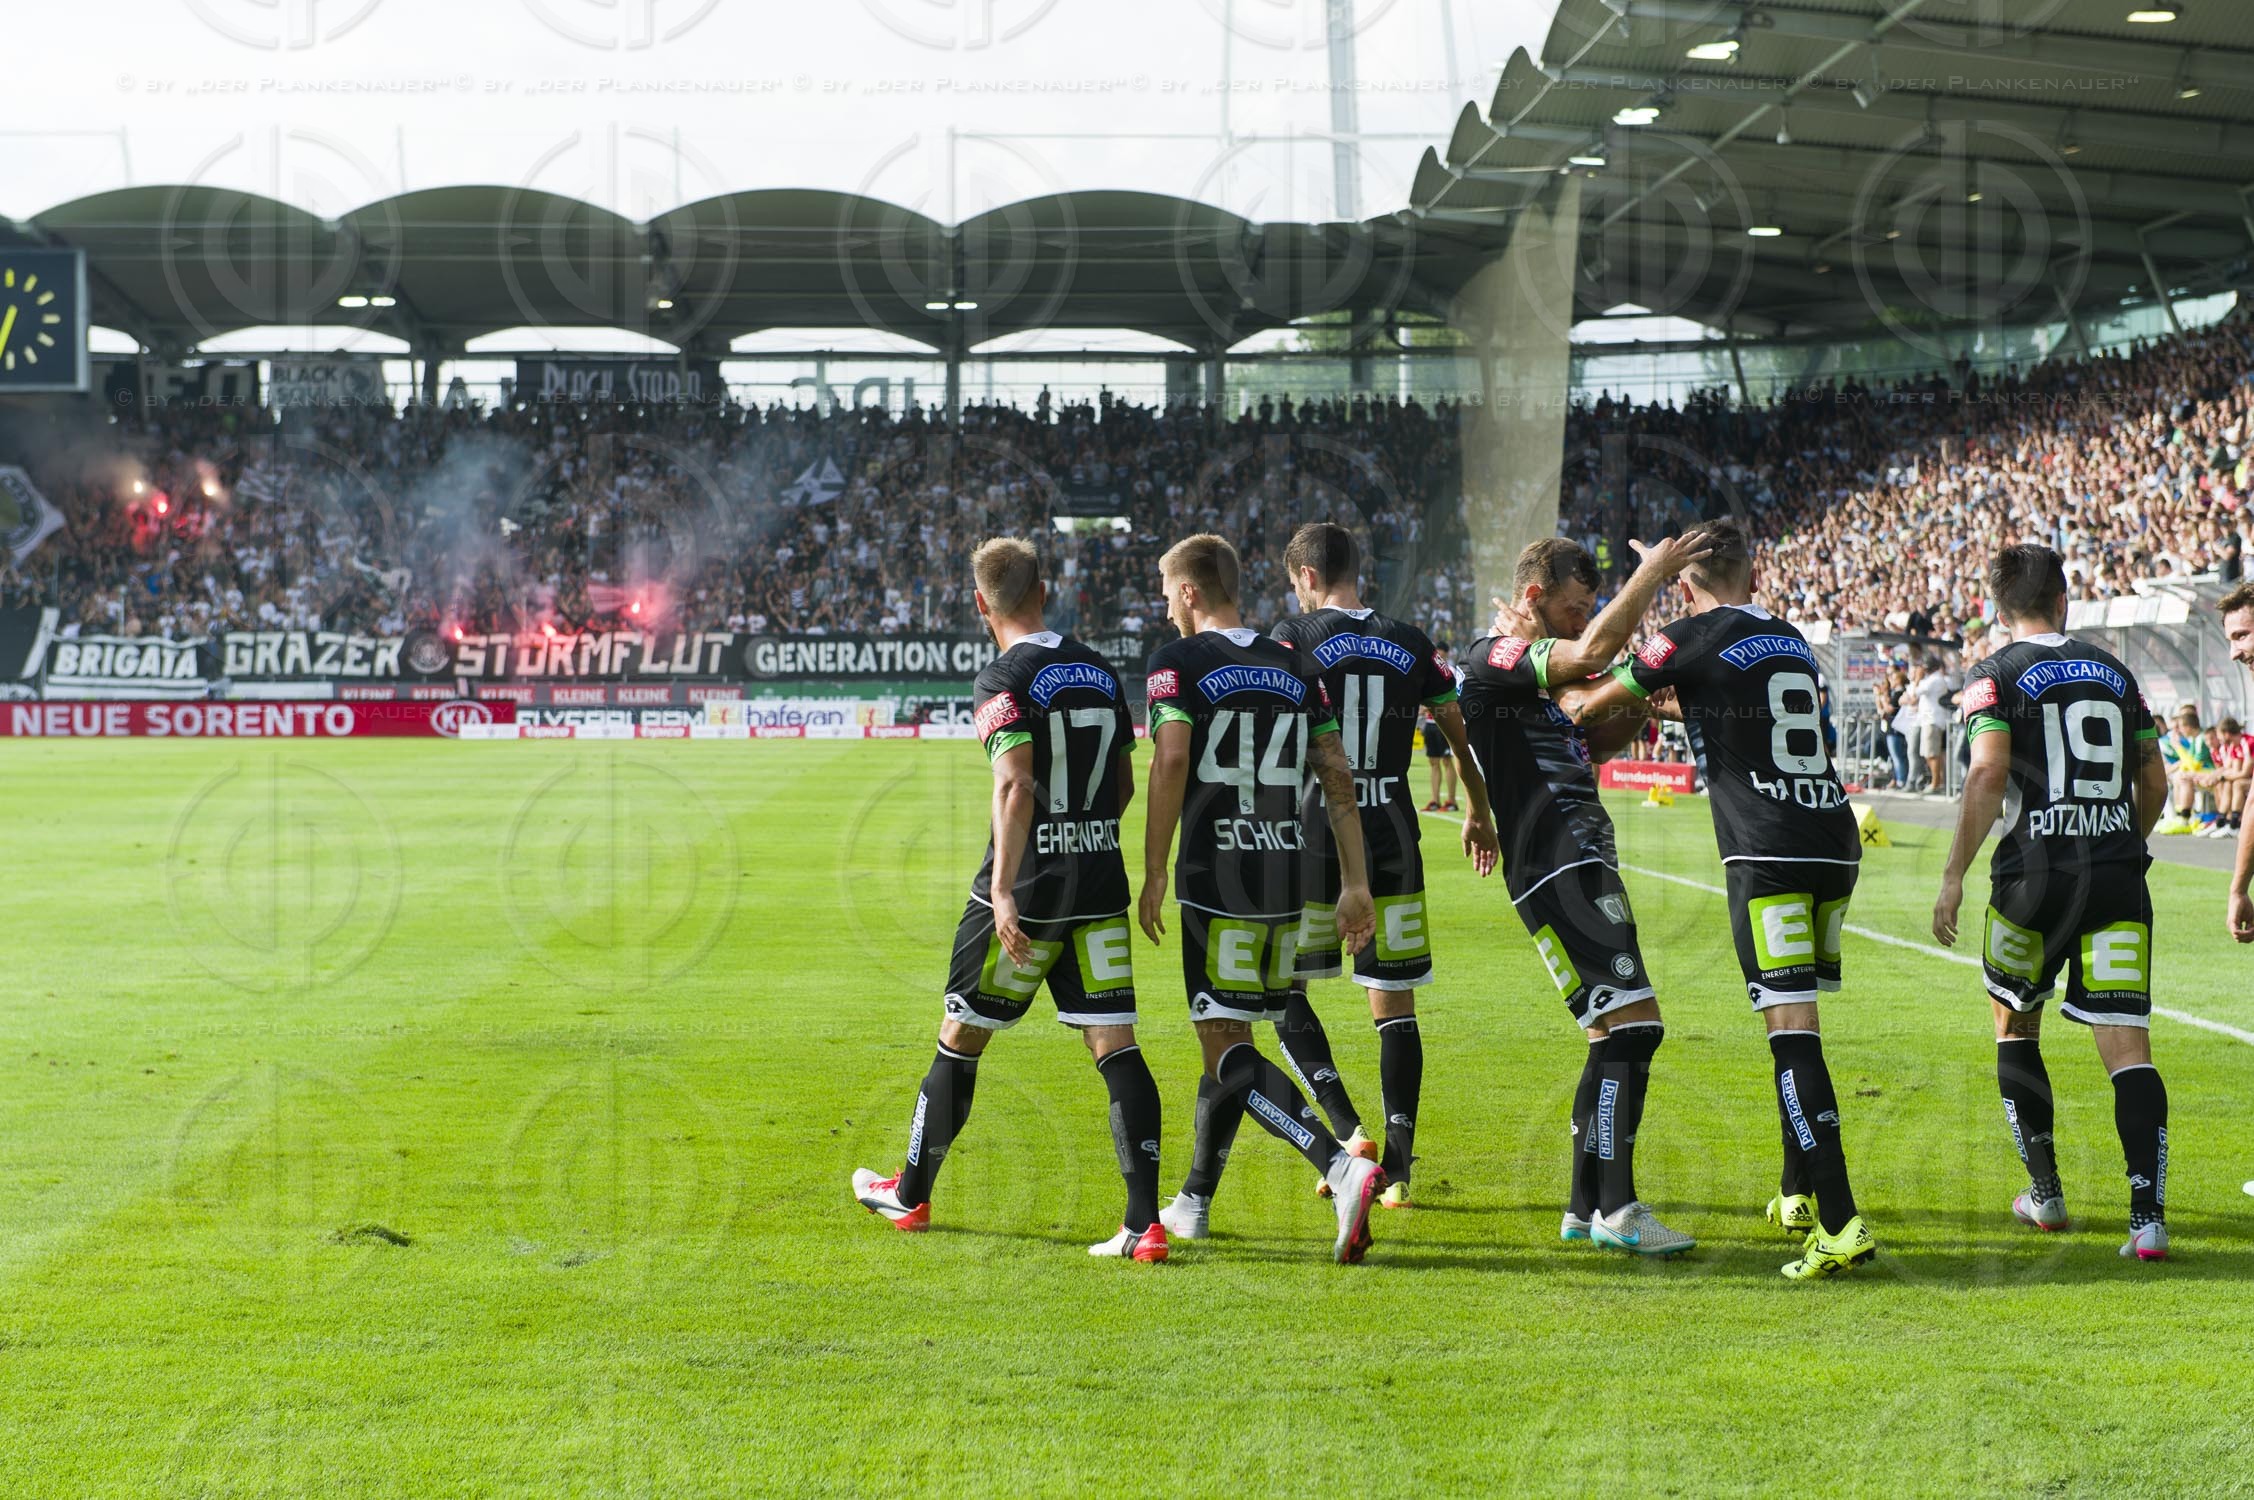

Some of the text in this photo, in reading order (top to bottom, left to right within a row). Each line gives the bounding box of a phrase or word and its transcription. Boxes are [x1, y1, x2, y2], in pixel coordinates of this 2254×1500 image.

[54, 643, 199, 678] BRIGATA
[224, 630, 404, 677] GRAZER
[454, 631, 735, 677] STURMFLUT
[755, 640, 947, 674] GENERATION
[413, 689, 456, 700] KLEIN
[553, 688, 606, 703] KLEINE
[618, 688, 670, 703] KLEINE
[690, 688, 742, 701] KLEINE
[1033, 666, 1114, 701] PUNTIGAMER
[1205, 669, 1302, 700] PUNTIGAMER
[2023, 663, 2123, 693] PUNTIGAMER
[12, 704, 131, 737] NEUE
[146, 703, 355, 737] SORENTO
[440, 708, 482, 730] KIA
[1342, 673, 1385, 770] 11
[1767, 671, 1828, 775] 8
[1049, 707, 1117, 814] 17
[1197, 709, 1309, 815] 44
[2042, 699, 2124, 802] 19
[1612, 769, 1687, 787] bundesliga.at
[1213, 818, 1307, 851] SCHICK
[2029, 801, 2131, 841] POTZMANN
[1384, 901, 1426, 952] E
[1762, 902, 1813, 958] E
[1990, 919, 2034, 971] E
[1085, 926, 1132, 981] E
[1218, 929, 1258, 982] E
[2091, 930, 2143, 982] E
[1761, 968, 1791, 980] ENERGIE
[1085, 989, 1115, 1000] ENERGIE
[1250, 1092, 1313, 1149] PUNTIGAMER
[1600, 1081, 1618, 1158] PUNTIGAMER
[1782, 1071, 1814, 1150] PUNTIGAMER
[1787, 1214, 1814, 1223] adidas
